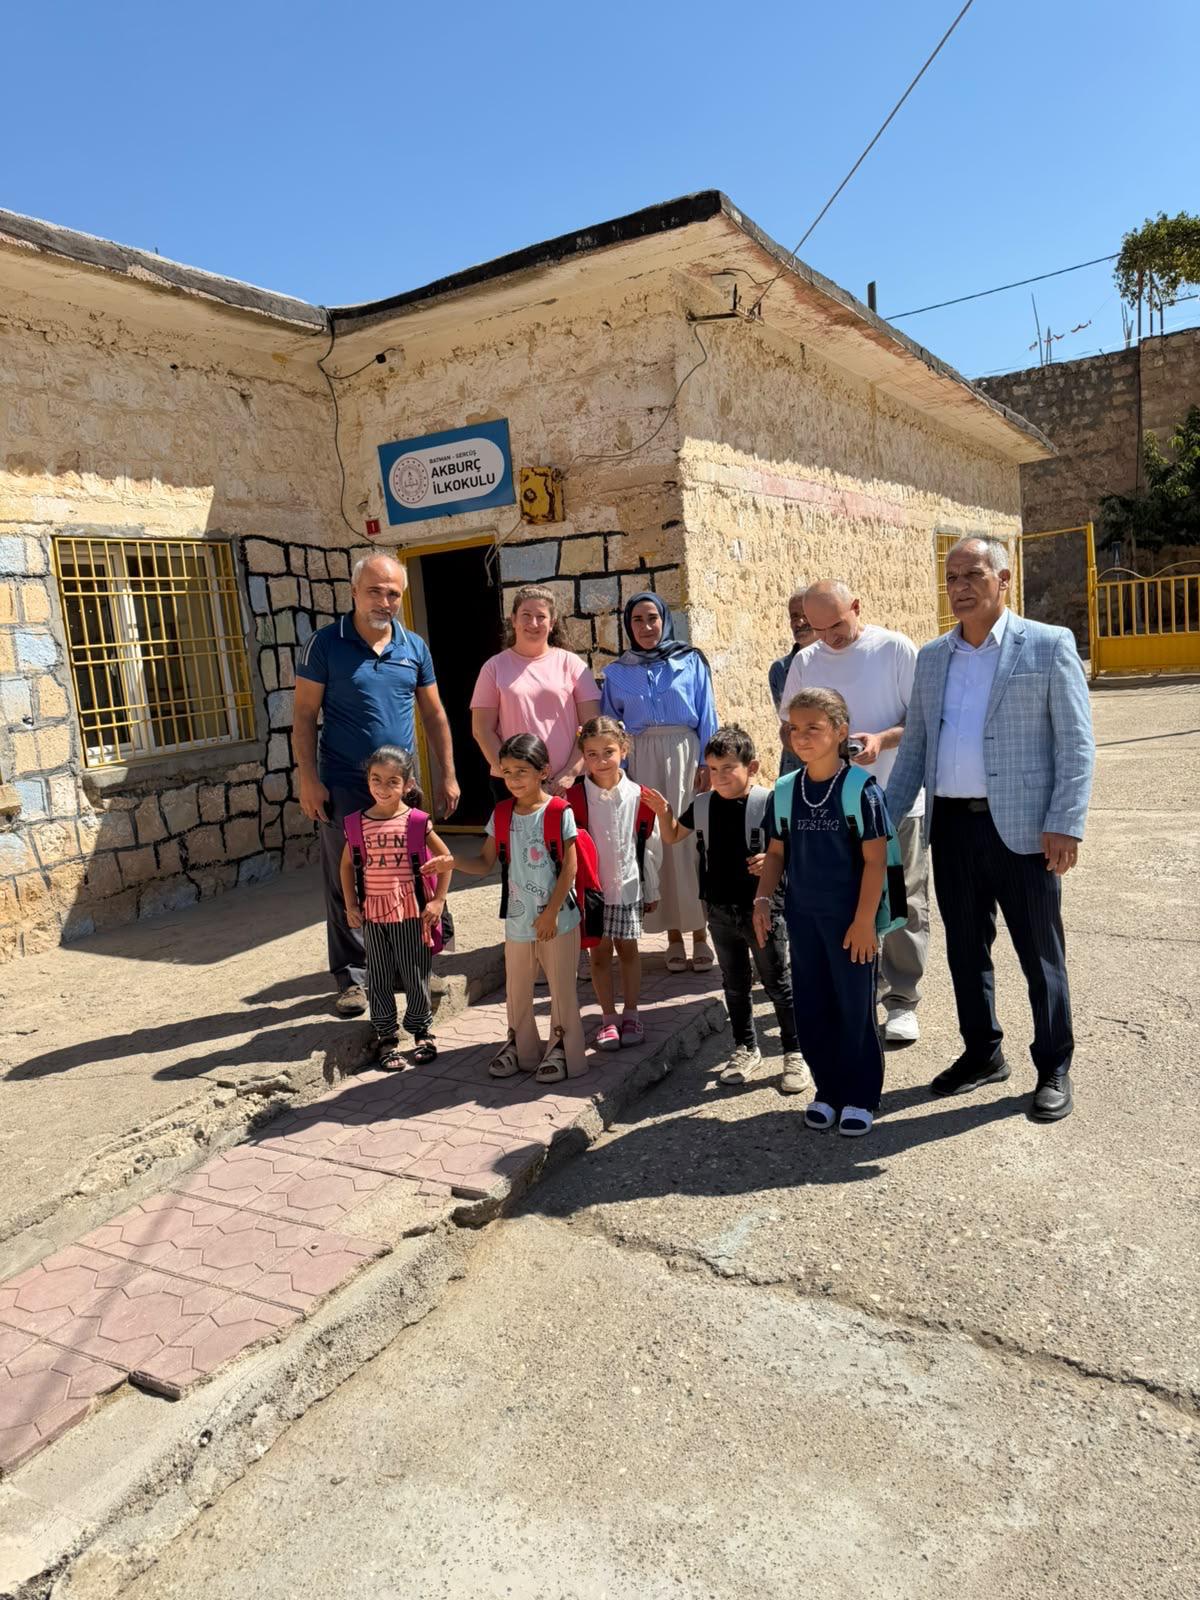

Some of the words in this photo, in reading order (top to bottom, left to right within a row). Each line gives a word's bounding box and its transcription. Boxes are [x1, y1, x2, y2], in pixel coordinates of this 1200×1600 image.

[430, 455, 451, 464] BATMAN
[432, 458, 481, 478] AKBURÇ
[433, 473, 496, 494] İLKOKULU
[365, 833, 405, 848] SUN
